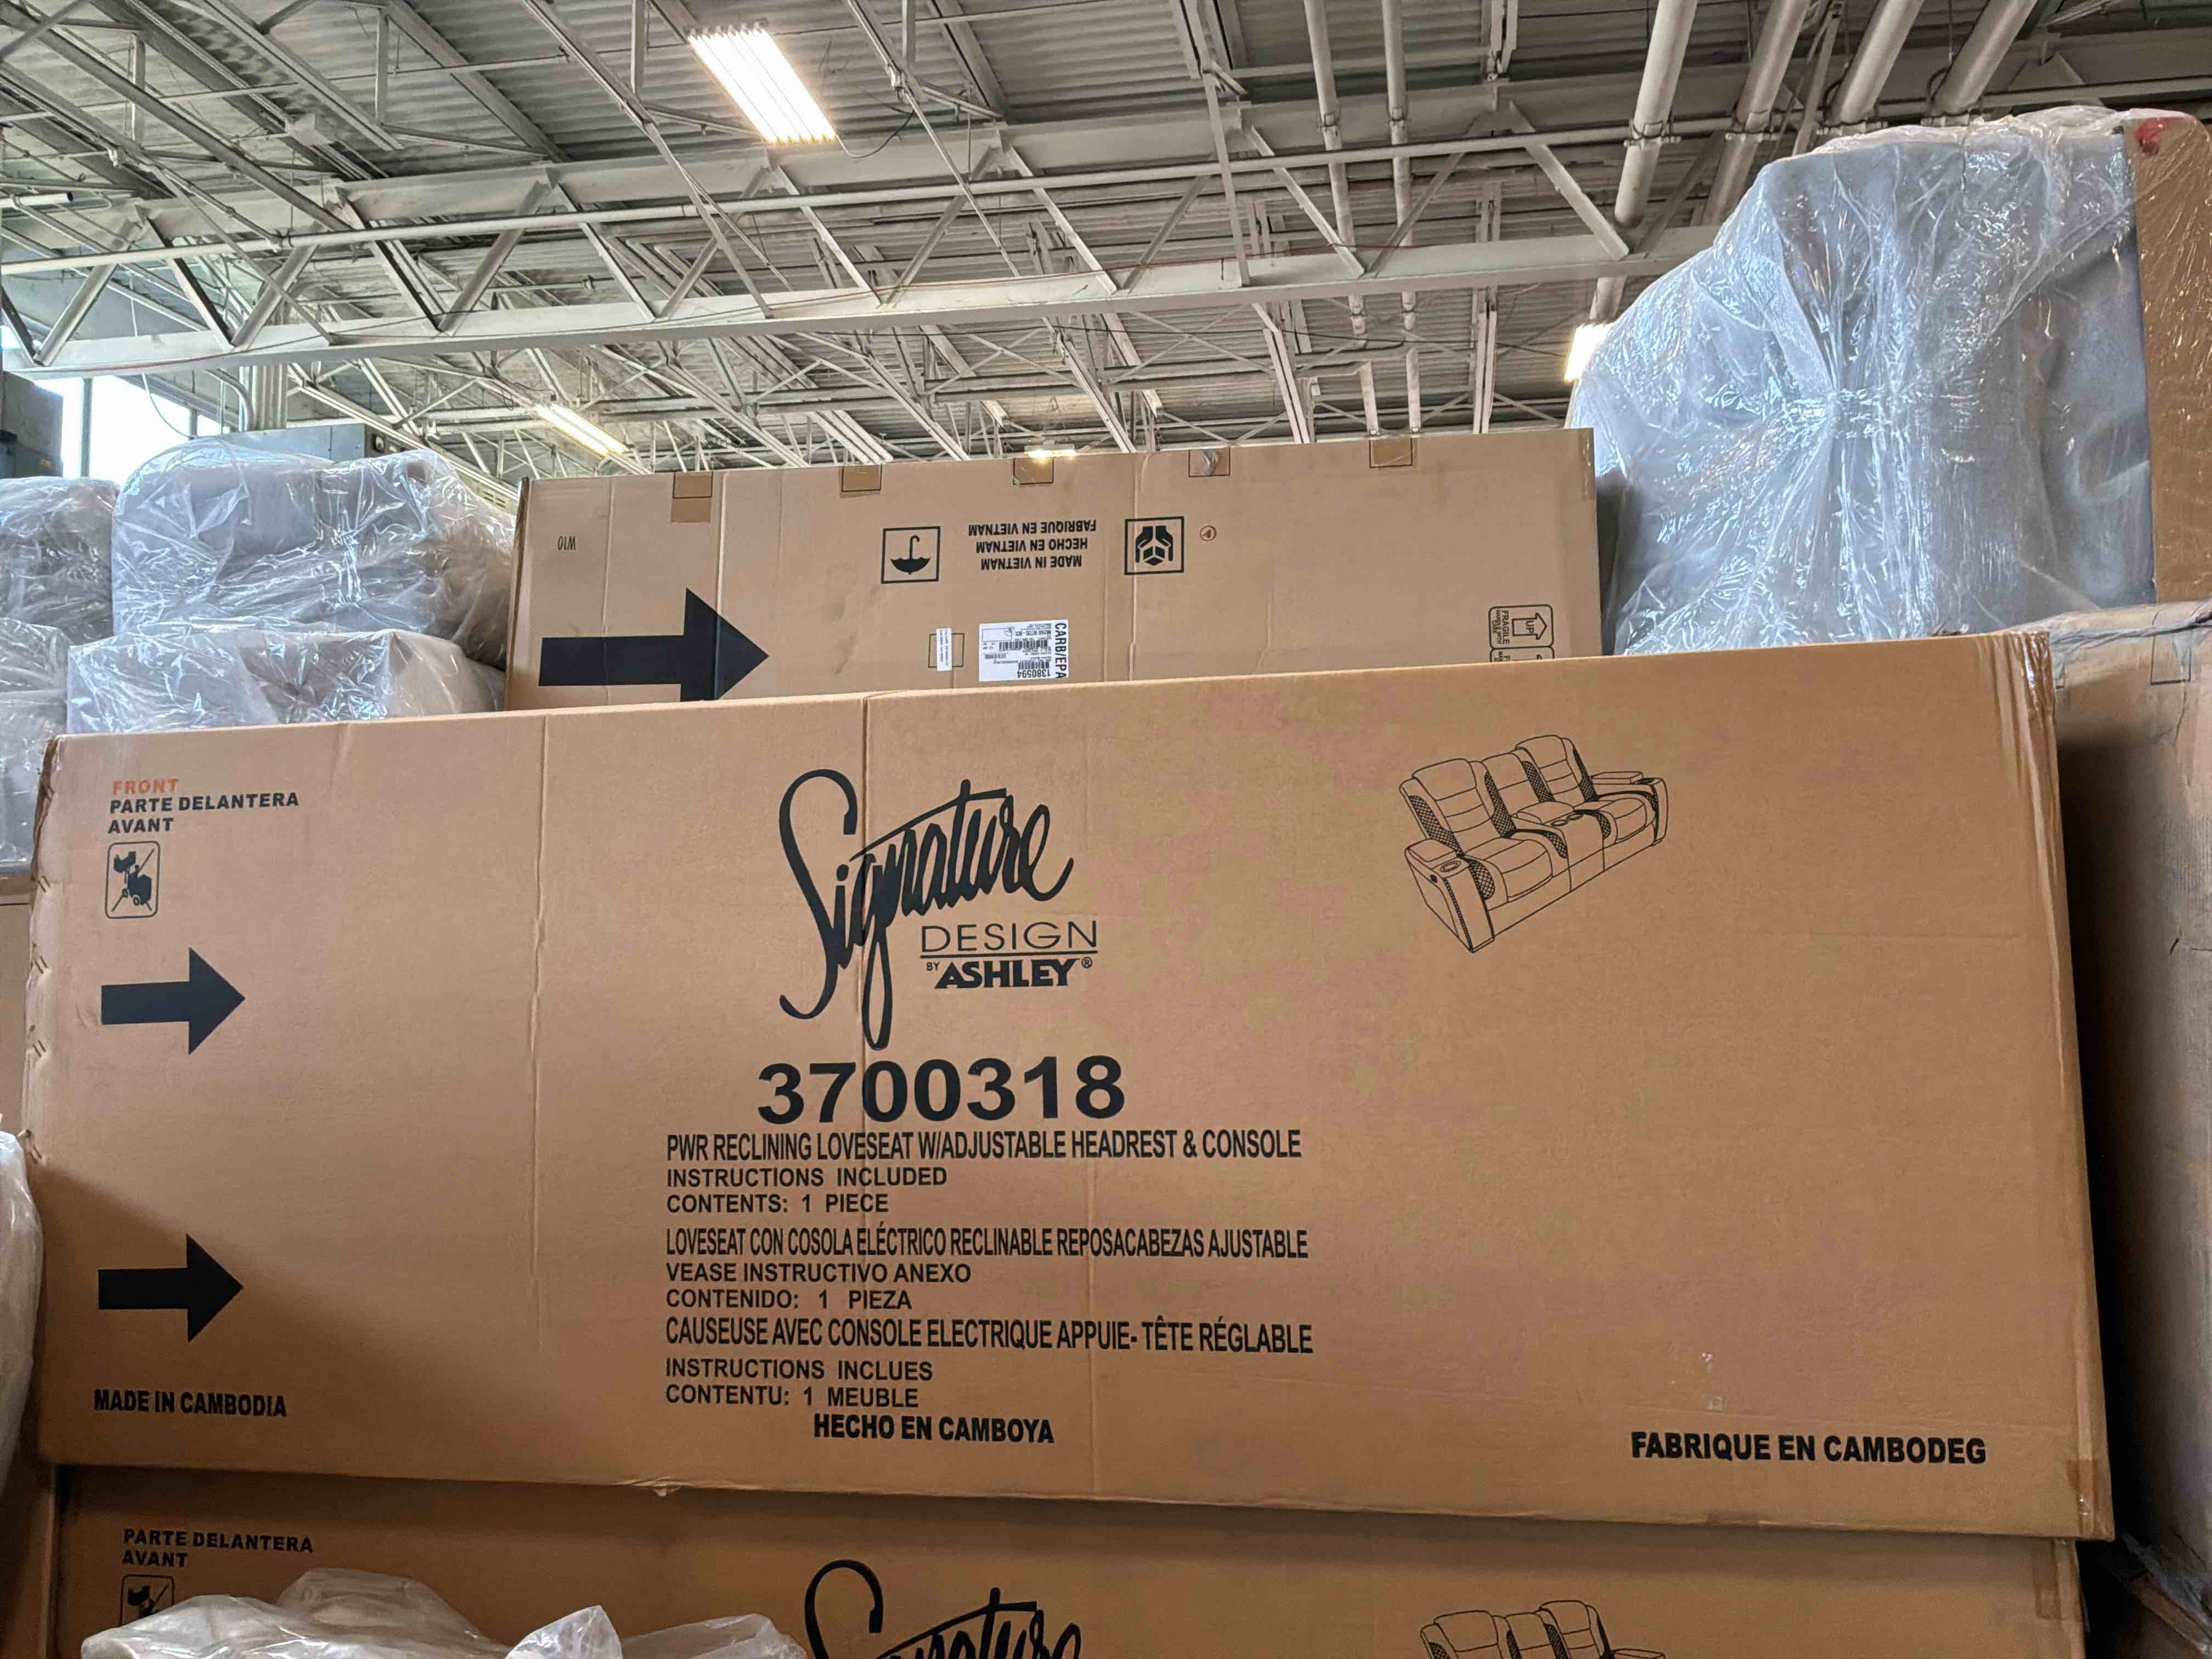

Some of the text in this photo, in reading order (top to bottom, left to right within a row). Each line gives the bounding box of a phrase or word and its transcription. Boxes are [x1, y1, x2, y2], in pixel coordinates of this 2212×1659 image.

[968, 520, 1096, 535] FABRIQUE EN VIETNAM
[975, 538, 1087, 553] HECHO EN VIETNAM
[981, 555, 1082, 570] MADE IN VIETNAM
[1502, 610, 1510, 645] FRAGILE
[1526, 621, 1534, 633] UP
[1054, 623, 1067, 679] CARB/EPA
[1017, 669, 1050, 678] 1380594
[113, 779, 178, 794] FRONT
[110, 793, 298, 813] PARTE DELANTERA
[108, 818, 173, 833] AVANT
[779, 769, 1074, 1051] Signature
[922, 920, 1097, 952] DESIGN
[927, 961, 940, 971] BY
[758, 1056, 1125, 1124] 3700318
[668, 1129, 1301, 1161] PWR RECLINING LOVESEAT W/ADJUSTABLE HEADREST & CONSOLE
[668, 1167, 947, 1187] INSTRUCTIONS INCLUDED
[668, 1194, 888, 1212] CONTENTS: 1 PIECE
[667, 1221, 1308, 1258] LOVESEAT CON COSOLA ELÉCTRICO RECLINABLE REPOSACABEZAS AJUSTABLE
[667, 1263, 970, 1283] VEASE INSTRUCTIVO ANEXO
[667, 1289, 912, 1309] CONTENIDO: 1 PIEZA
[667, 1317, 768, 1344] CAUSEUSE
[772, 1318, 822, 1345] AVEC
[828, 1318, 921, 1346] CONSOLE
[928, 1319, 1052, 1350] ELECTRIQUE
[1142, 1316, 1193, 1351] TÊTE
[1200, 1316, 1313, 1353] RÉGLABLE
[666, 1359, 933, 1381] INSTRUCTIONS INCLUES
[94, 1390, 286, 1417] MADE IN CAMBODIA
[666, 1385, 918, 1407] CONTENTU: 1 MEUBLE
[814, 1414, 1054, 1443] HECHO EN CAMBOYA
[1631, 1432, 1986, 1464] FABRIQUE EN CAMBODEG
[123, 1529, 312, 1553] PARTE DELANTERA
[122, 1550, 187, 1567] AVANT
